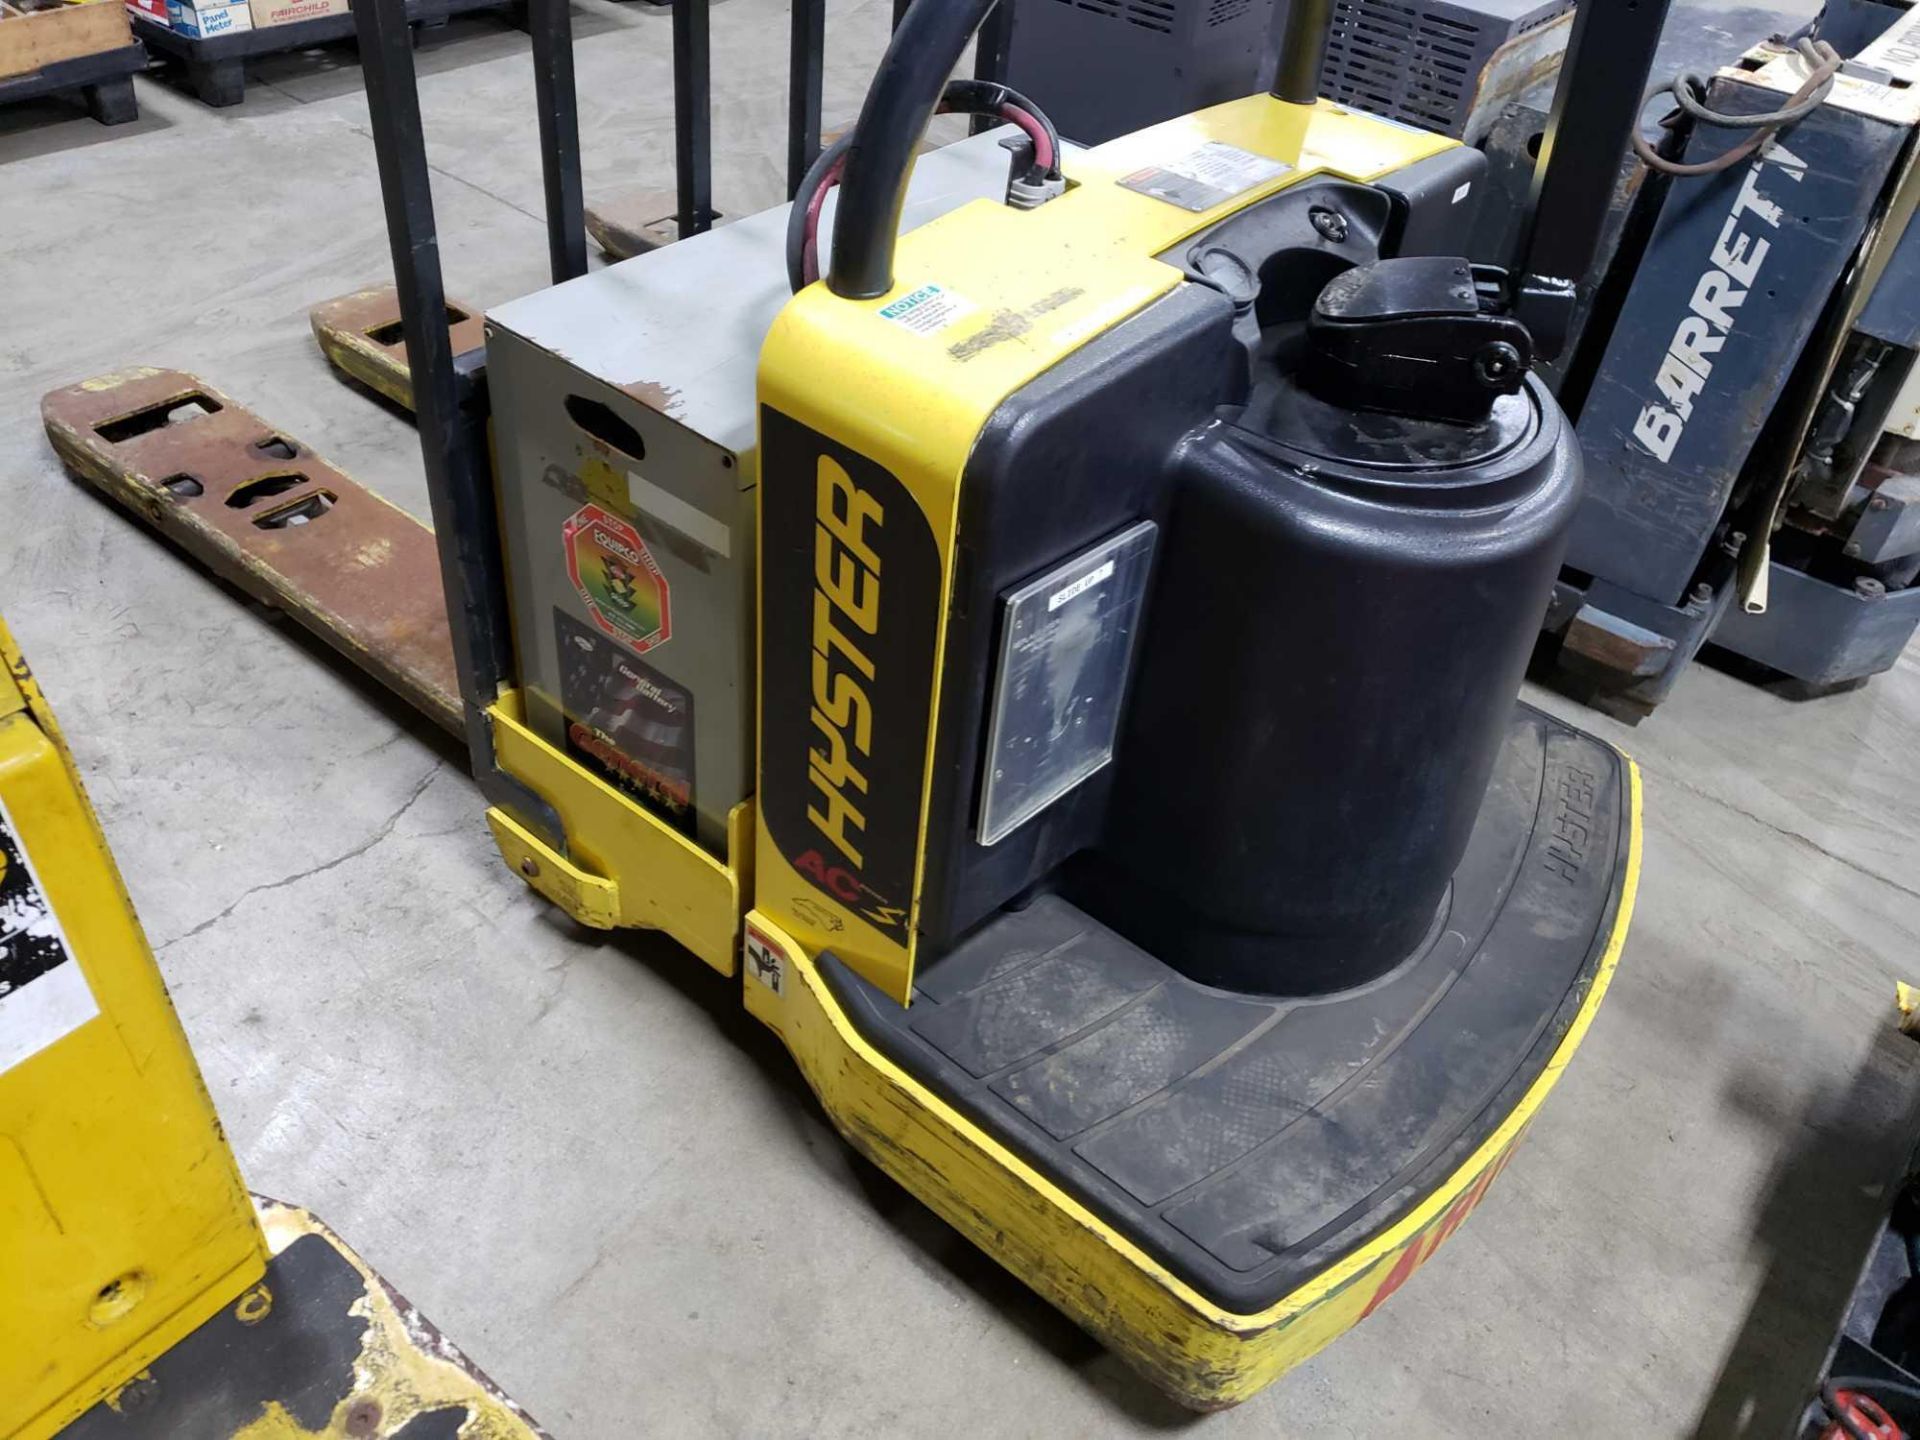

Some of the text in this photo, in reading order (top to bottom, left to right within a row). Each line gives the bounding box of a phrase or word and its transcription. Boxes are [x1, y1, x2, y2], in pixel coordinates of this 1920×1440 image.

[202, 9, 228, 24] Panel
[271, 1, 330, 18] FAIRCHILD
[205, 19, 232, 34] Meter
[882, 285, 938, 319] NOTICE
[808, 454, 884, 871] HYSTER
[619, 664, 662, 694] General
[637, 681, 677, 713] Battery
[793, 848, 861, 902] AC
